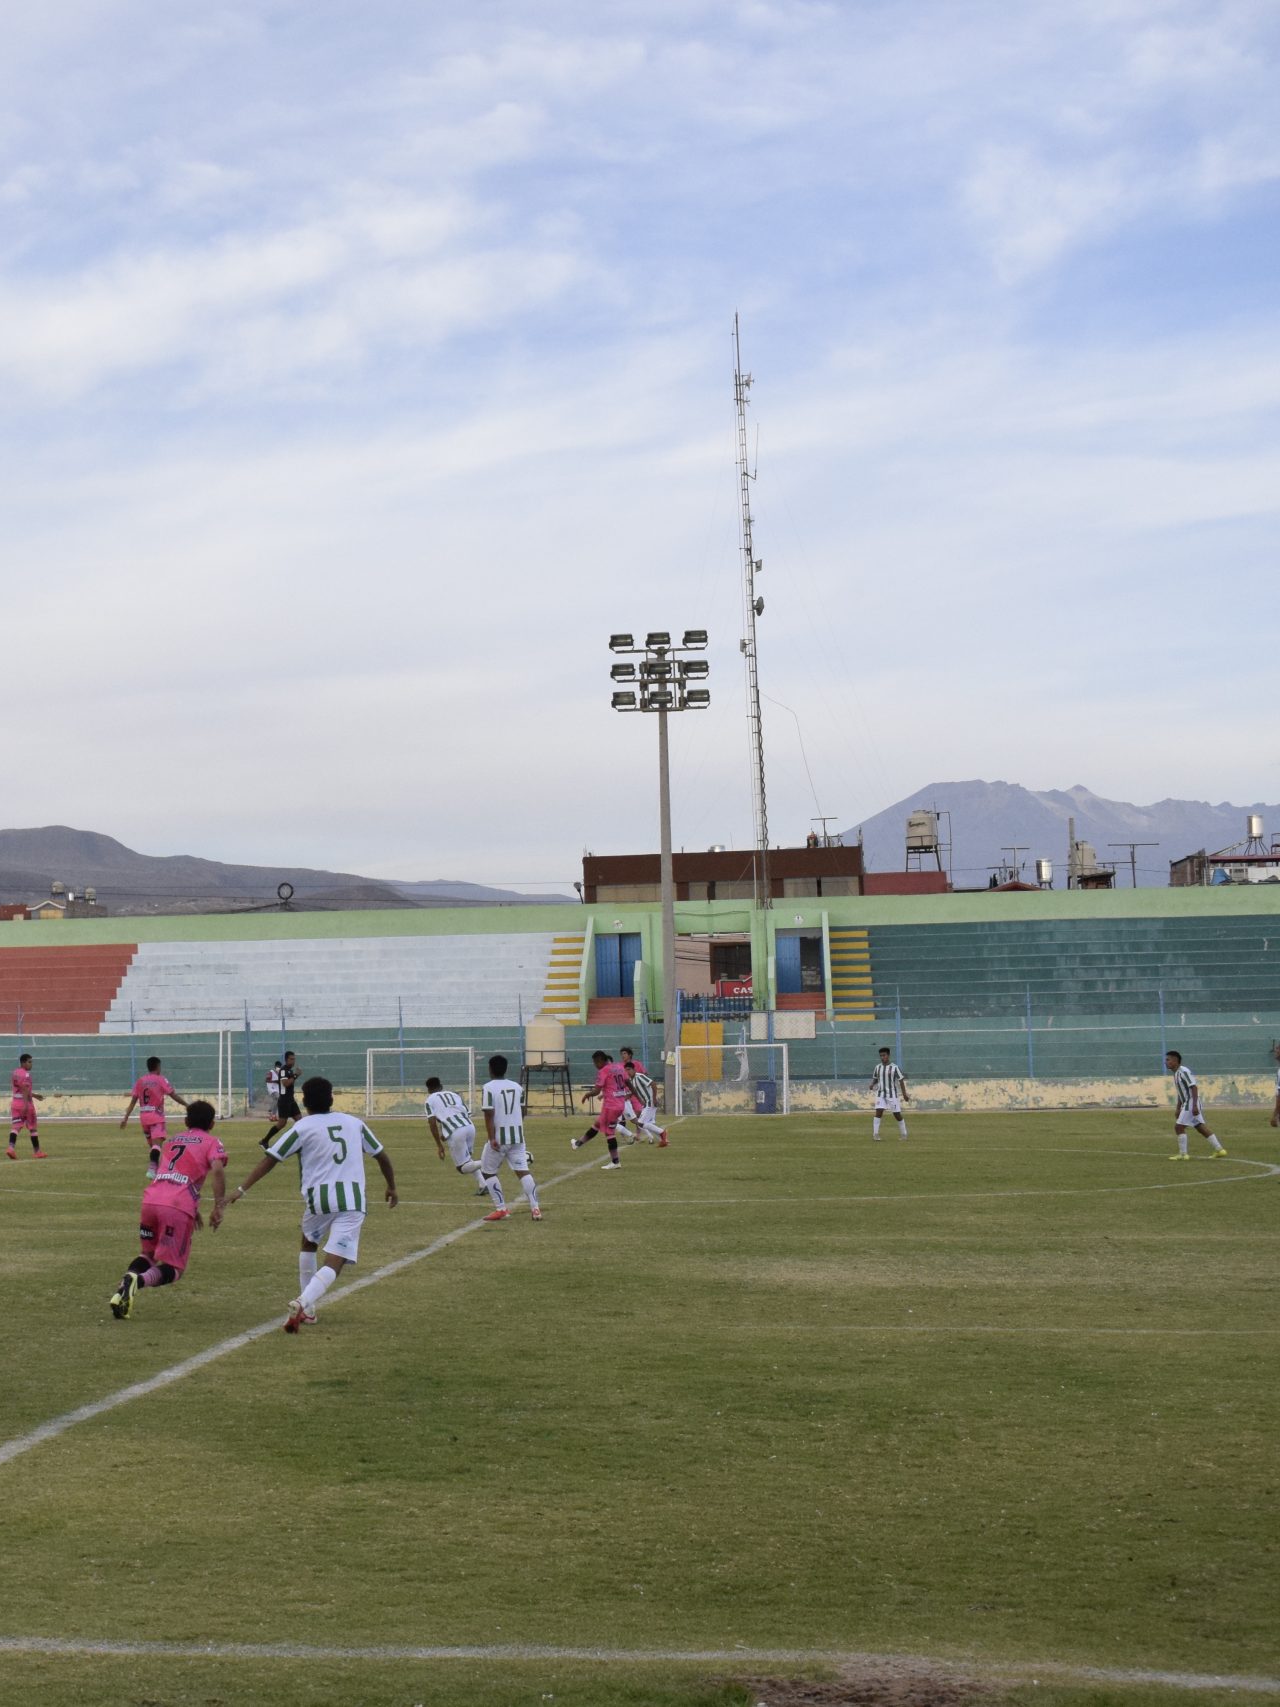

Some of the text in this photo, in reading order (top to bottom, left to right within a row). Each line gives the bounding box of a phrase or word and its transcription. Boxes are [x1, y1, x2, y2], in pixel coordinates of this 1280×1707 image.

[143, 1087, 150, 1105] 6
[437, 1092, 457, 1108] 10
[500, 1089, 516, 1115] 17
[169, 1144, 186, 1171] 7
[327, 1125, 348, 1165] 5
